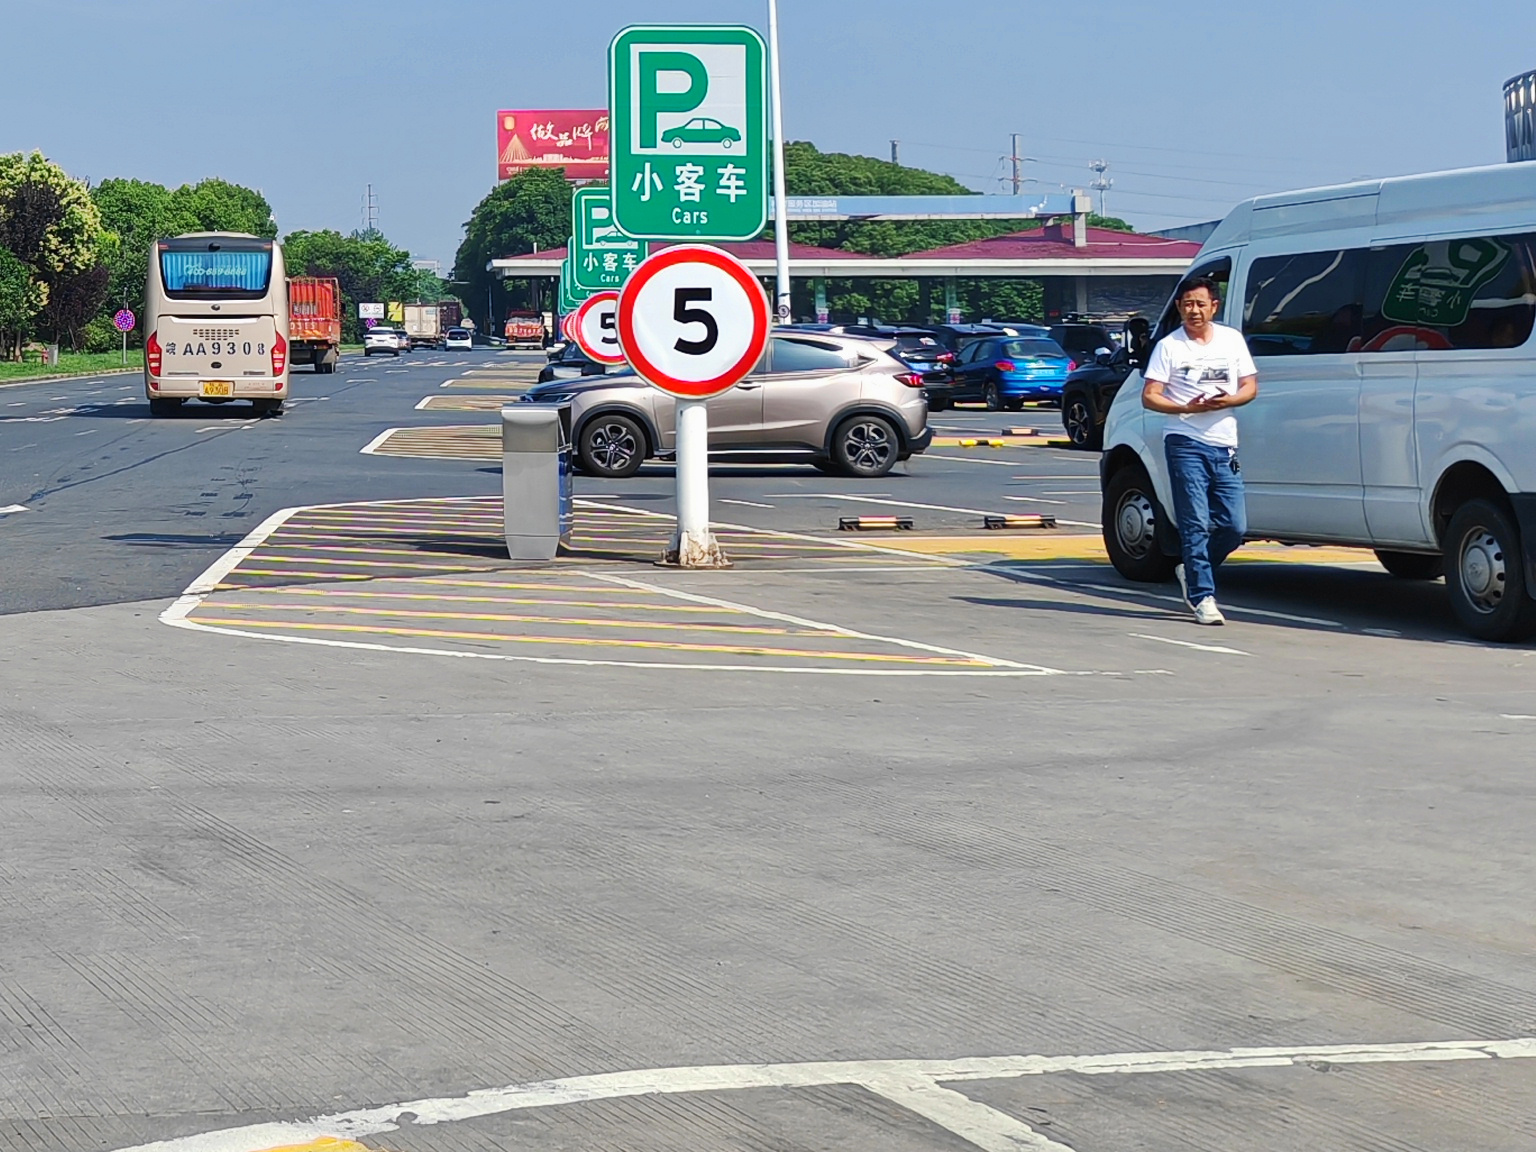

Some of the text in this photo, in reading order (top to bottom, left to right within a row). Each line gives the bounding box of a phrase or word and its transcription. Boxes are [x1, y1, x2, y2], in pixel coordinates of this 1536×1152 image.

[639, 51, 708, 148] P
[631, 163, 748, 203] 小客车
[672, 208, 708, 224] Cars
[583, 252, 638, 272] 小客车
[600, 274, 620, 283] Cars
[600, 312, 618, 344] 5
[674, 288, 718, 355] 5
